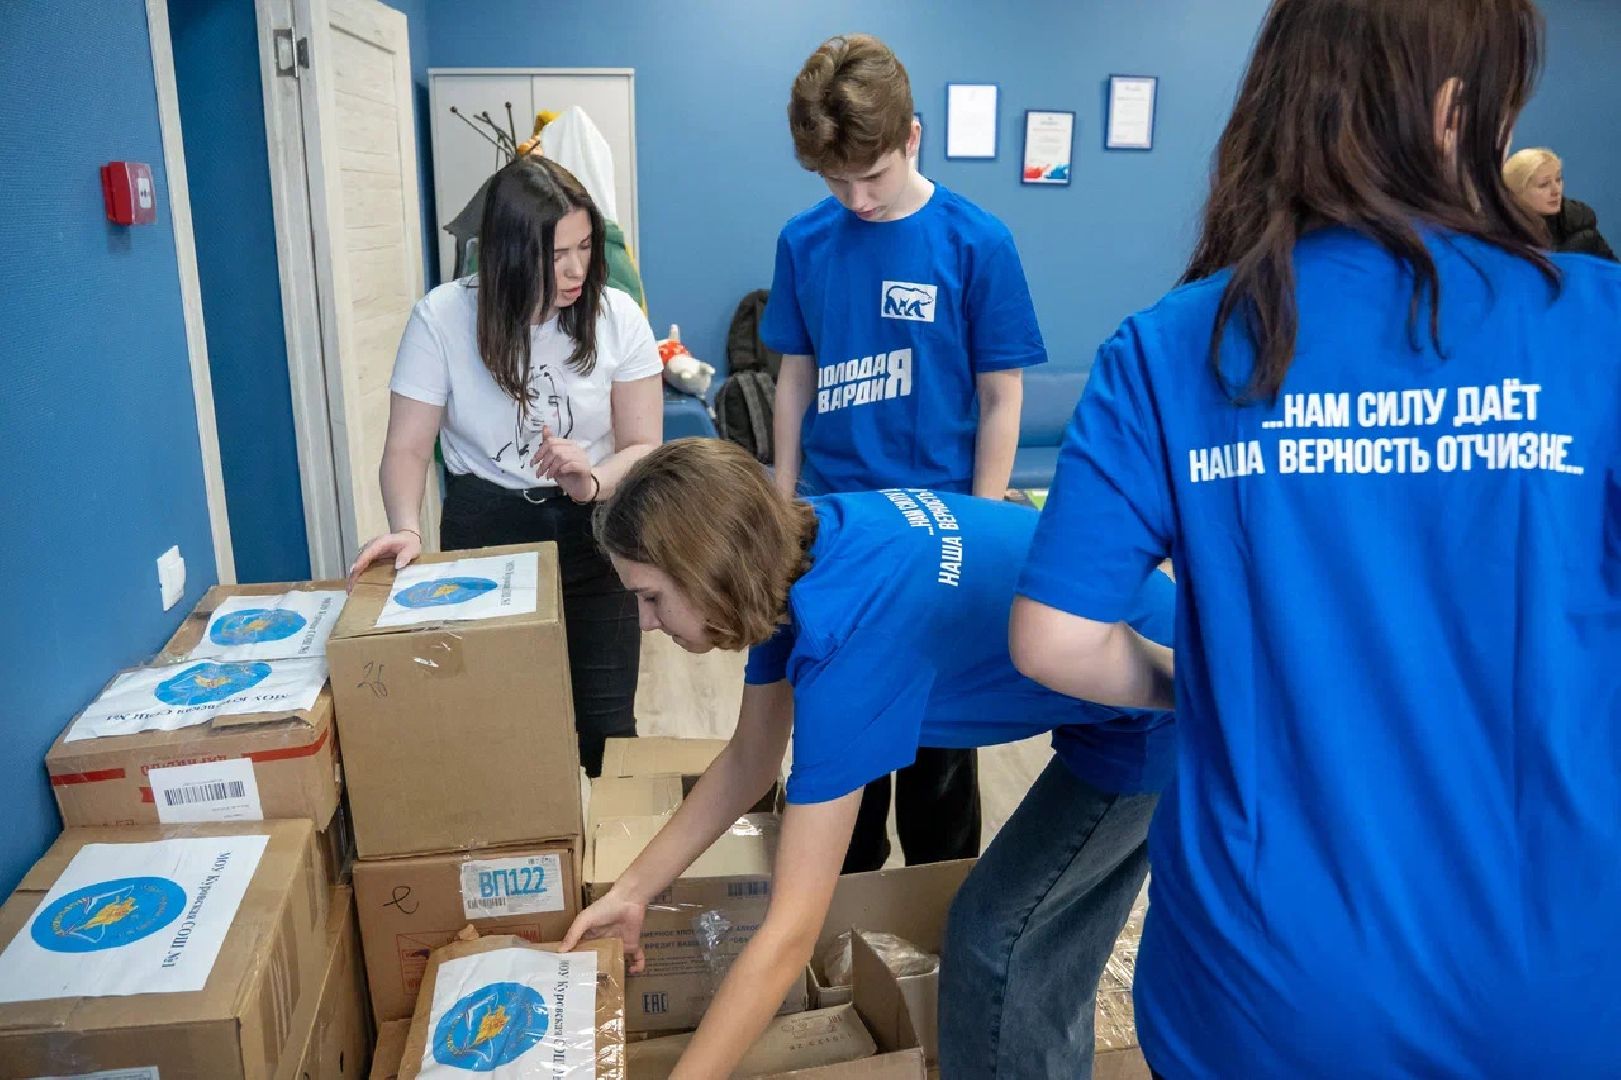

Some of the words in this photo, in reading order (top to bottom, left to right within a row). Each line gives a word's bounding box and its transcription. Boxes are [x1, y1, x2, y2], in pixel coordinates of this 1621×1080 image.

[1262, 392, 1349, 429] ...НАМ
[1357, 387, 1447, 428] СИЛУ
[1453, 378, 1541, 426] ДАЁТ
[1189, 440, 1266, 483] НАША
[1278, 436, 1432, 474] ВЕРНОСТЬ
[938, 536, 963, 587] НАША
[211, 852, 232, 873] МОУ
[479, 866, 548, 898] ВП122
[170, 920, 196, 949] СОШ
